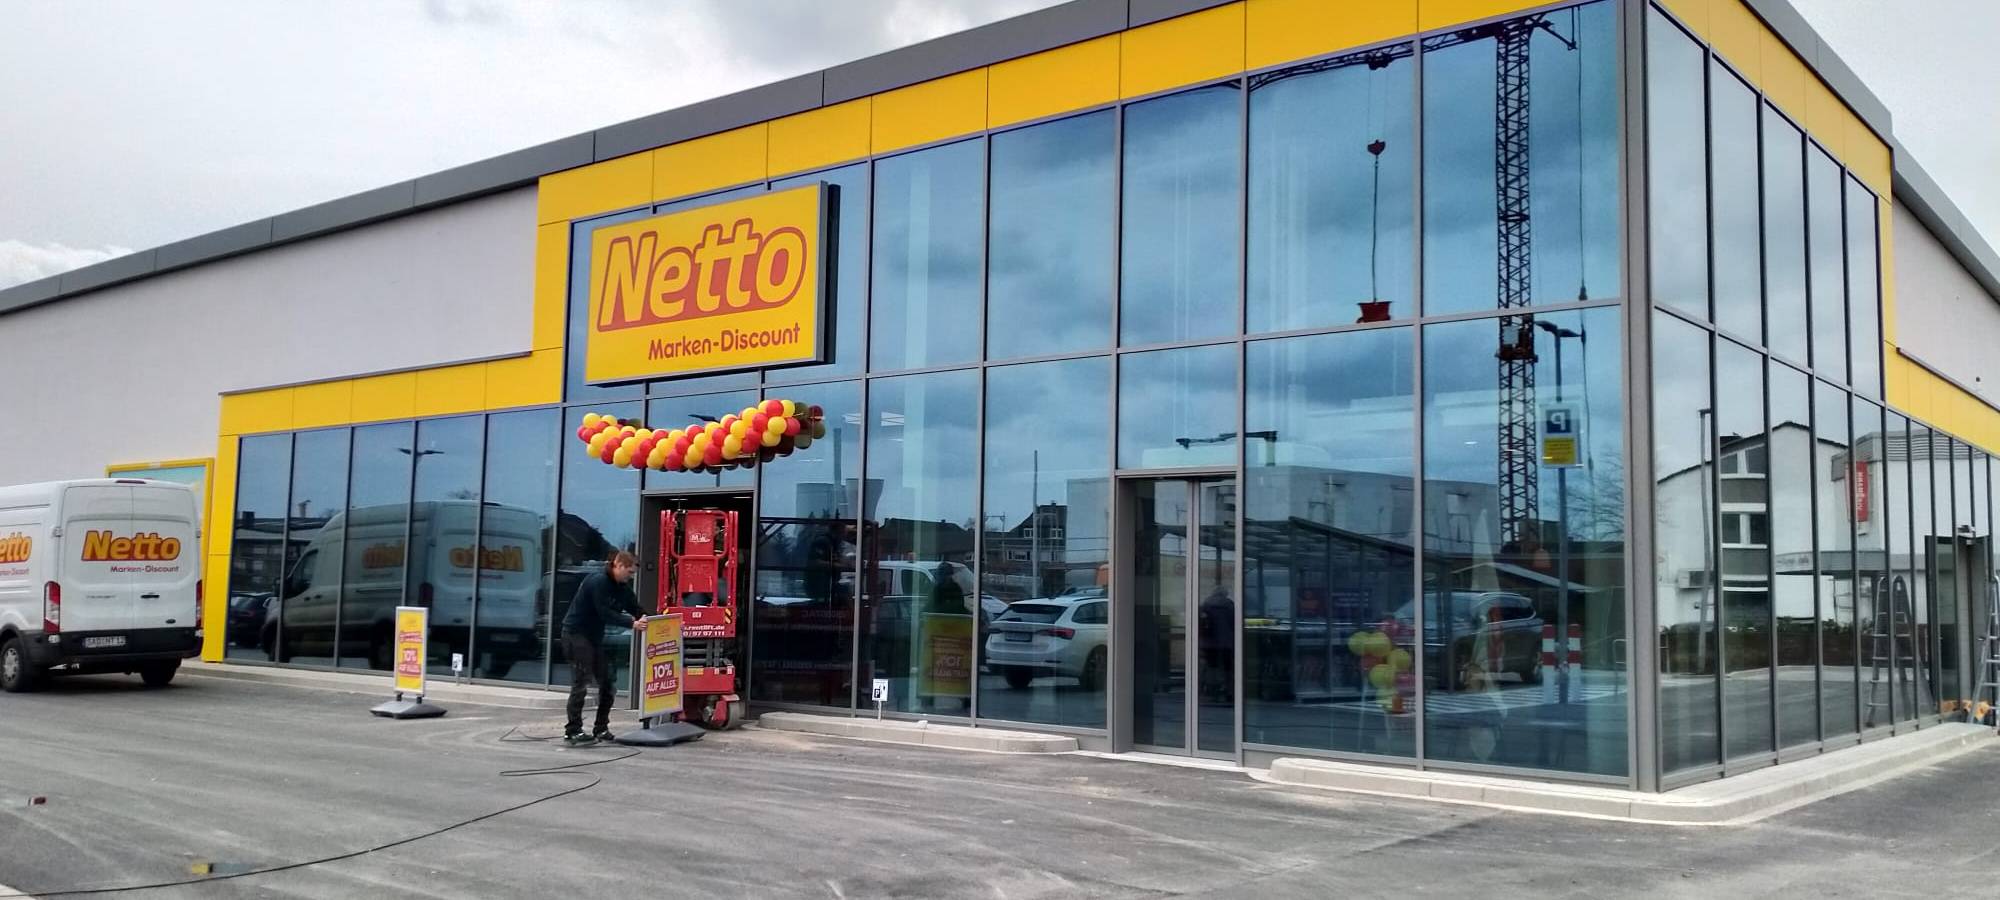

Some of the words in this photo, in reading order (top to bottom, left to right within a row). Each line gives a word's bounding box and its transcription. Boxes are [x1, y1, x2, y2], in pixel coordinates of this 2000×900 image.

[597, 218, 807, 332] Netto
[648, 322, 800, 360] Marken-Discount
[0, 532, 33, 563] etto
[81, 530, 181, 561] Netto
[110, 565, 180, 574] Marken-Discount
[646, 682, 660, 693] AUF
[659, 679, 676, 691] ALLES
[654, 663, 673, 679] 10%
